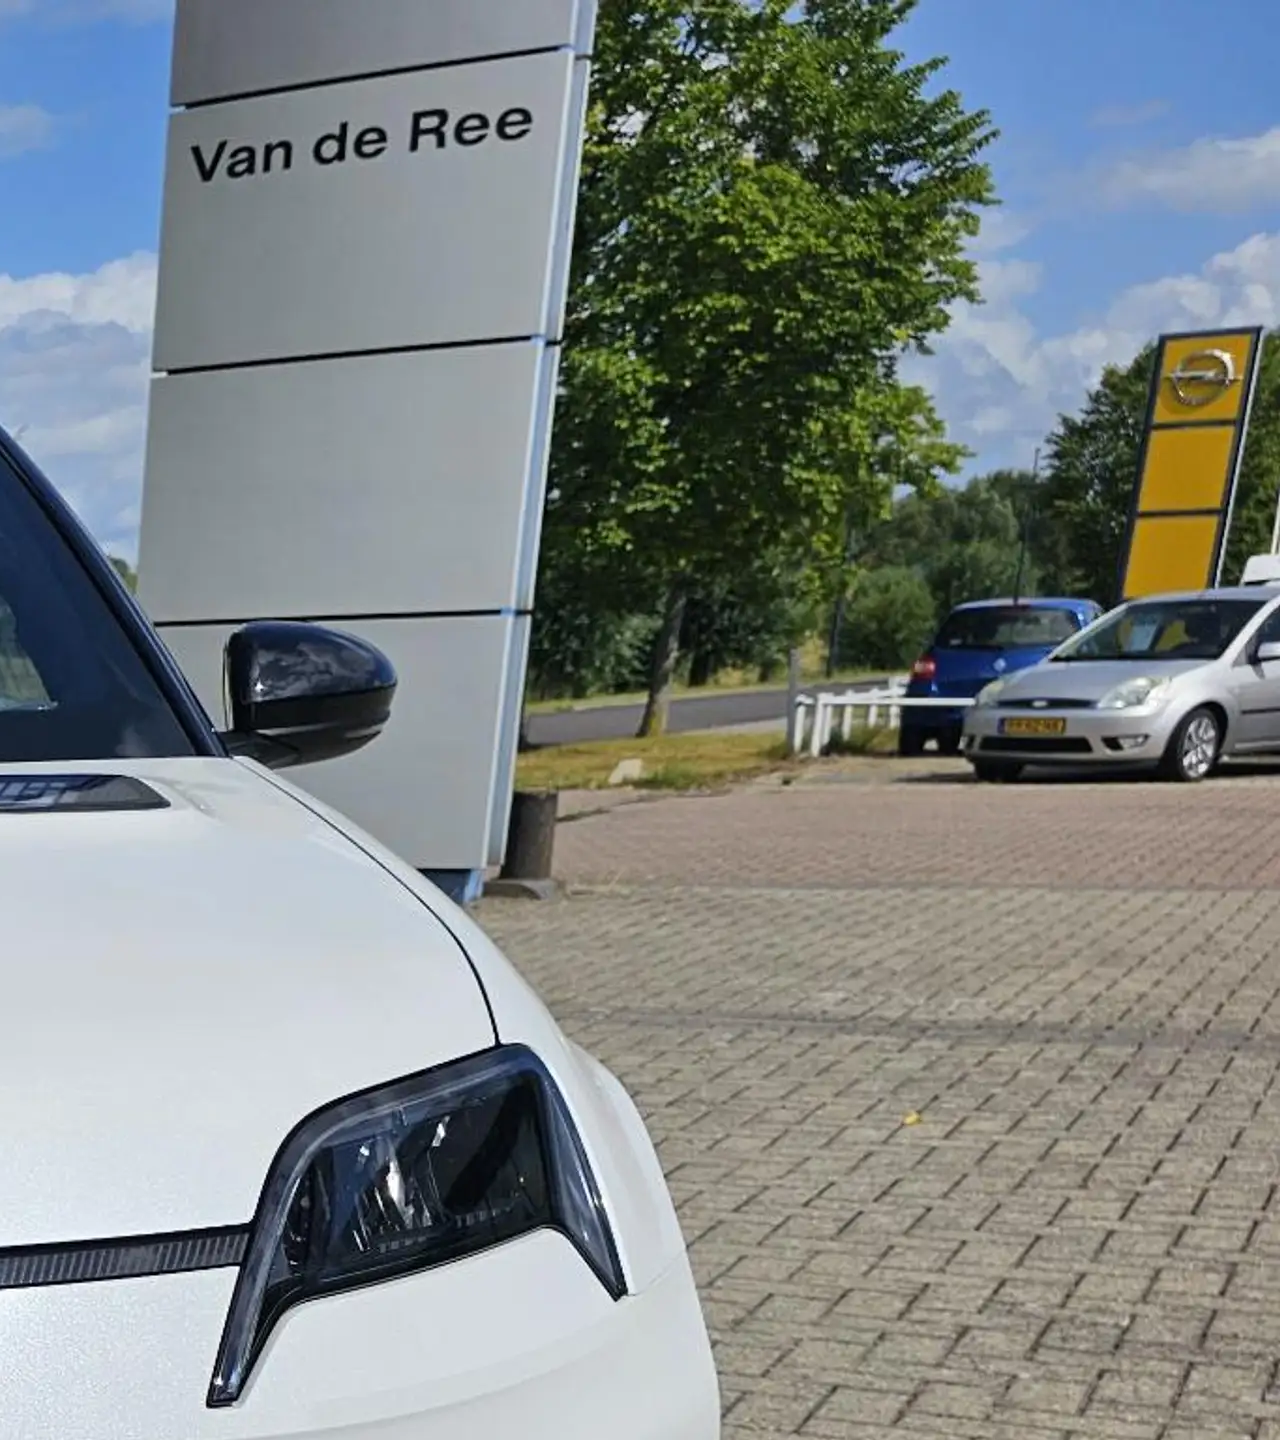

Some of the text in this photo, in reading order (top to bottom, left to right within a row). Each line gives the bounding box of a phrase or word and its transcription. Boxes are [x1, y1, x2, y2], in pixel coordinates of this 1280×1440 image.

[190, 107, 532, 182] Van de Ree
